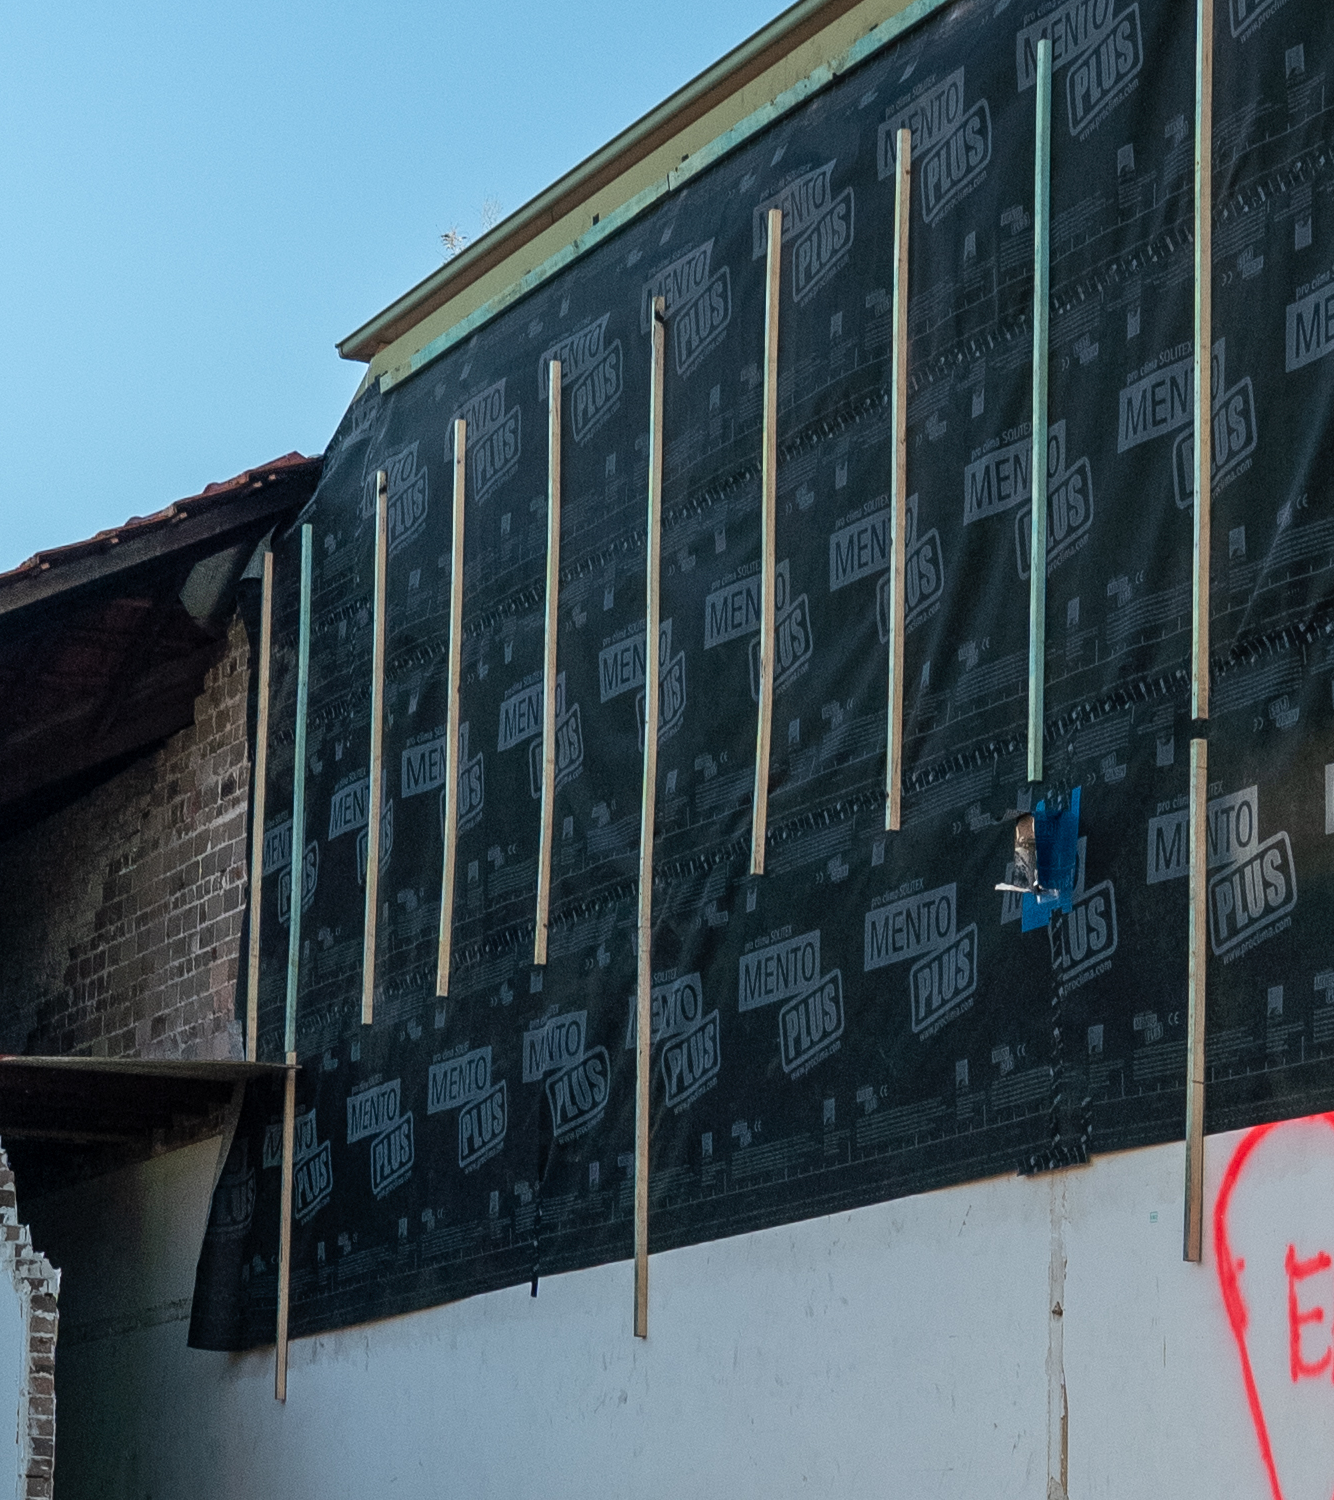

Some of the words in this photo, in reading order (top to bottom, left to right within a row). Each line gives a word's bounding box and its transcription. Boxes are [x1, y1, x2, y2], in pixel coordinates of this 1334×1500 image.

[1074, 21, 1134, 120] PLUS
[927, 116, 984, 208] PLUS
[799, 203, 846, 288] PLUS
[679, 281, 724, 362] PLUS
[1296, 283, 1310, 300] pro
[1159, 341, 1193, 364] SOLITEX
[577, 353, 616, 429] PLUS
[1126, 352, 1217, 440] MEN
[477, 419, 515, 490] PLUS
[970, 436, 1059, 512] MENO
[835, 507, 913, 580] MEN
[710, 573, 783, 639] MENO
[604, 631, 667, 694] MENO
[1156, 801, 1252, 873] MNTO
[1157, 802, 1170, 815] pro
[871, 896, 951, 961] MENTO
[1216, 849, 1285, 939] PLUS
[745, 942, 815, 1002] MENTO
[1223, 916, 1292, 965] www.proclima.com
[917, 939, 970, 1019] PLUS
[786, 983, 837, 1059] PLUS
[432, 1056, 486, 1106] MENTO
[667, 1023, 714, 1095] PLUS
[351, 1089, 397, 1134] MENTO
[463, 1092, 503, 1156] PLUS
[297, 1151, 327, 1209] PLUS
[376, 1123, 409, 1184] PLUS
